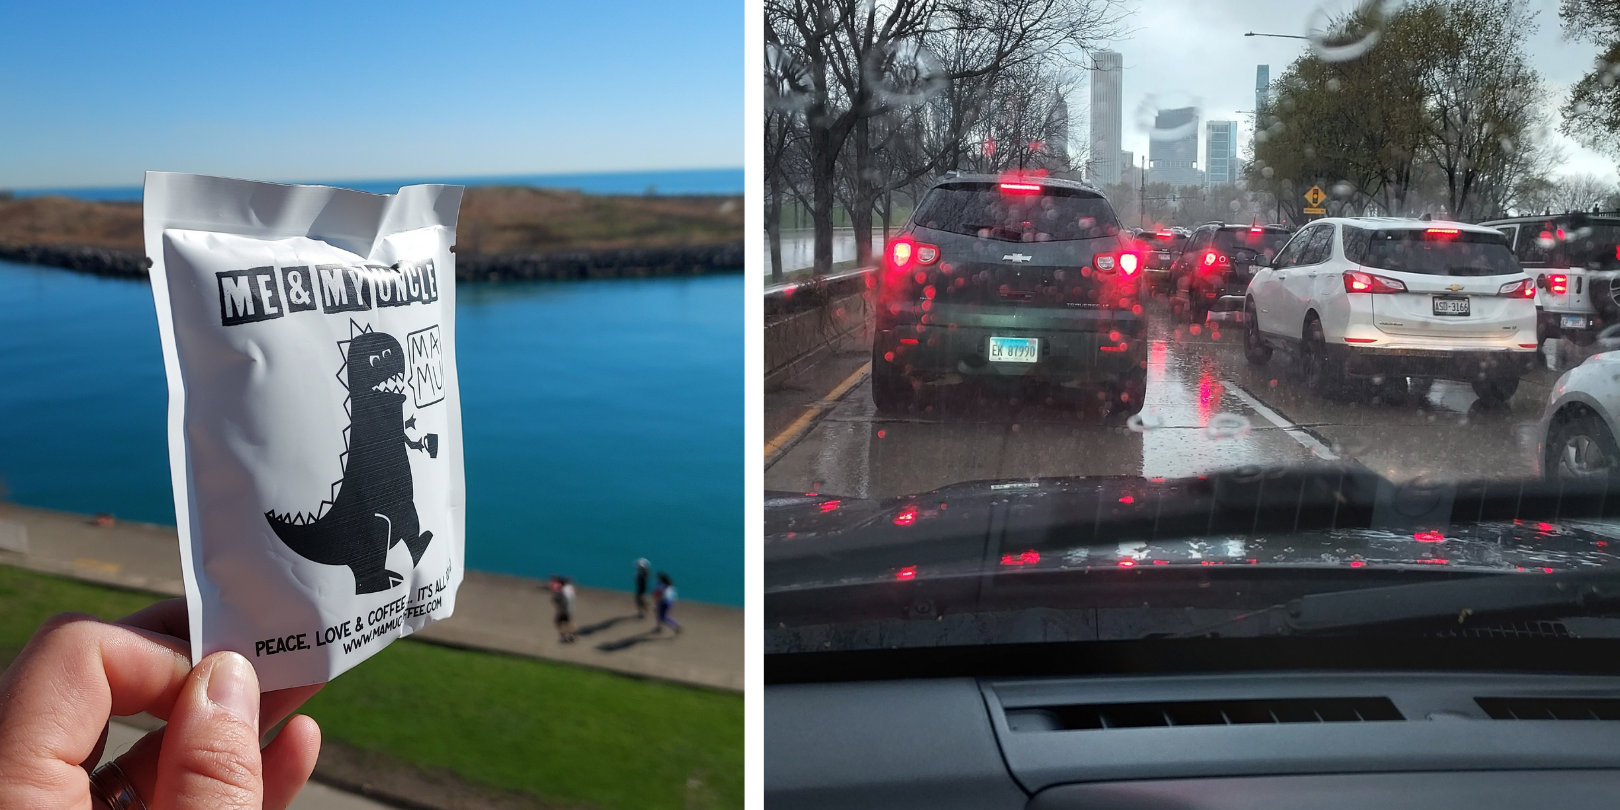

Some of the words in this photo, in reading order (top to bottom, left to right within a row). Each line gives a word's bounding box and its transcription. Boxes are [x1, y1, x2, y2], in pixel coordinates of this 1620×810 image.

[220, 272, 280, 319] ME
[286, 269, 311, 306] &
[319, 267, 364, 307] MY
[372, 263, 437, 302] UNCLE
[411, 331, 440, 364] MA
[992, 344, 1003, 357] EK
[1008, 344, 1036, 358] 87990
[417, 359, 443, 400] MU
[255, 633, 310, 657] PEACE,
[316, 620, 351, 647] LOVE
[355, 616, 364, 632] &
[417, 583, 433, 602] IT'S
[434, 575, 446, 594] ALL
[343, 595, 442, 655] WWW.MAMUCFFEE.COM
